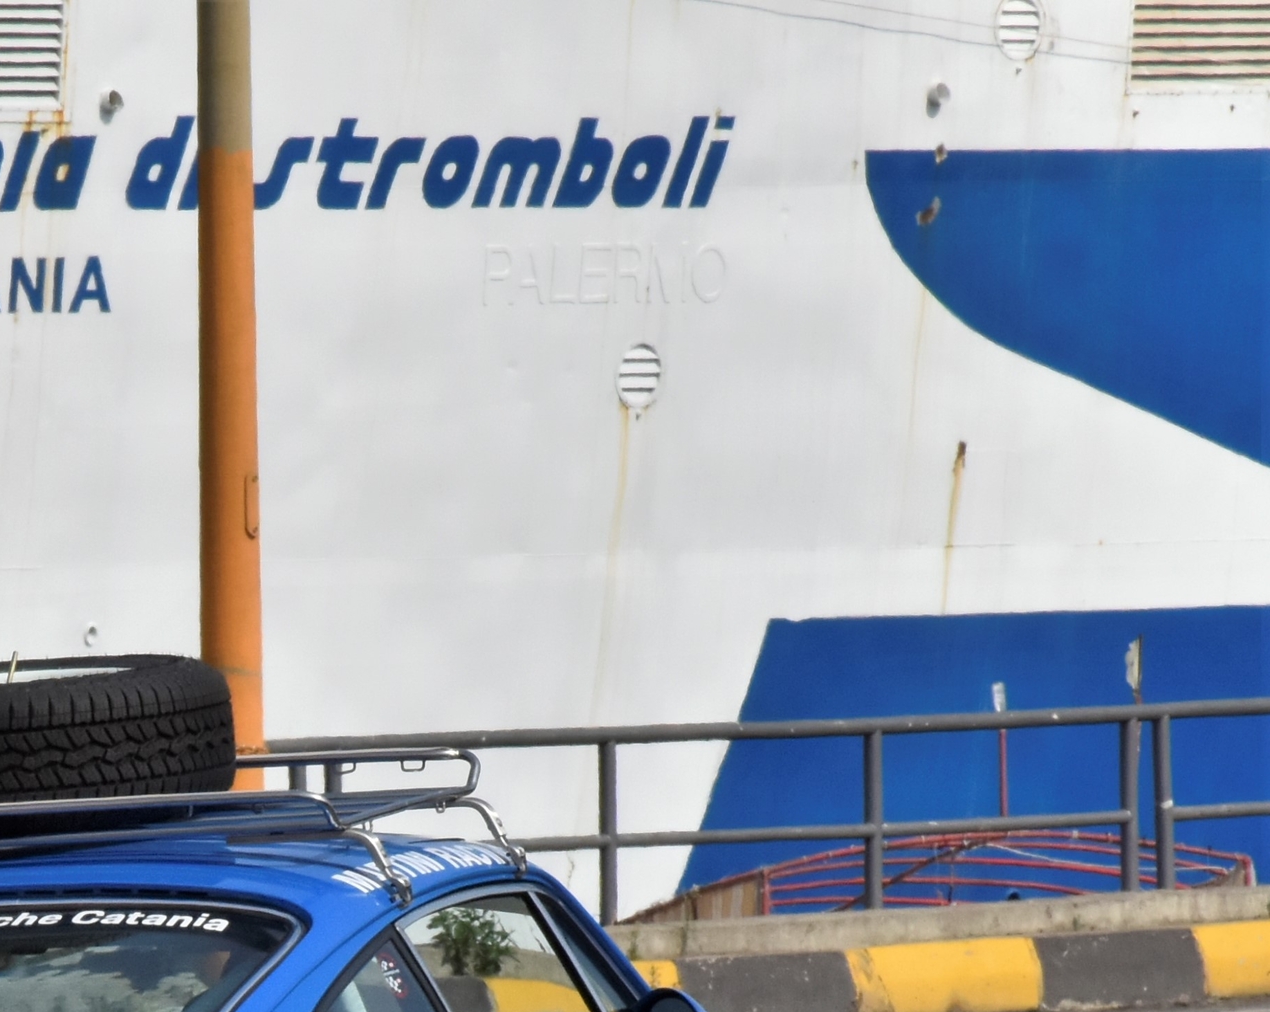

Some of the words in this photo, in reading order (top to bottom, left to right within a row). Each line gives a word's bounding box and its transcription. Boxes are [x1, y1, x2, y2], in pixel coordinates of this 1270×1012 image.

[253, 115, 735, 210] stromboli
[482, 241, 728, 307] PALERMO
[71, 910, 230, 932] Catania
